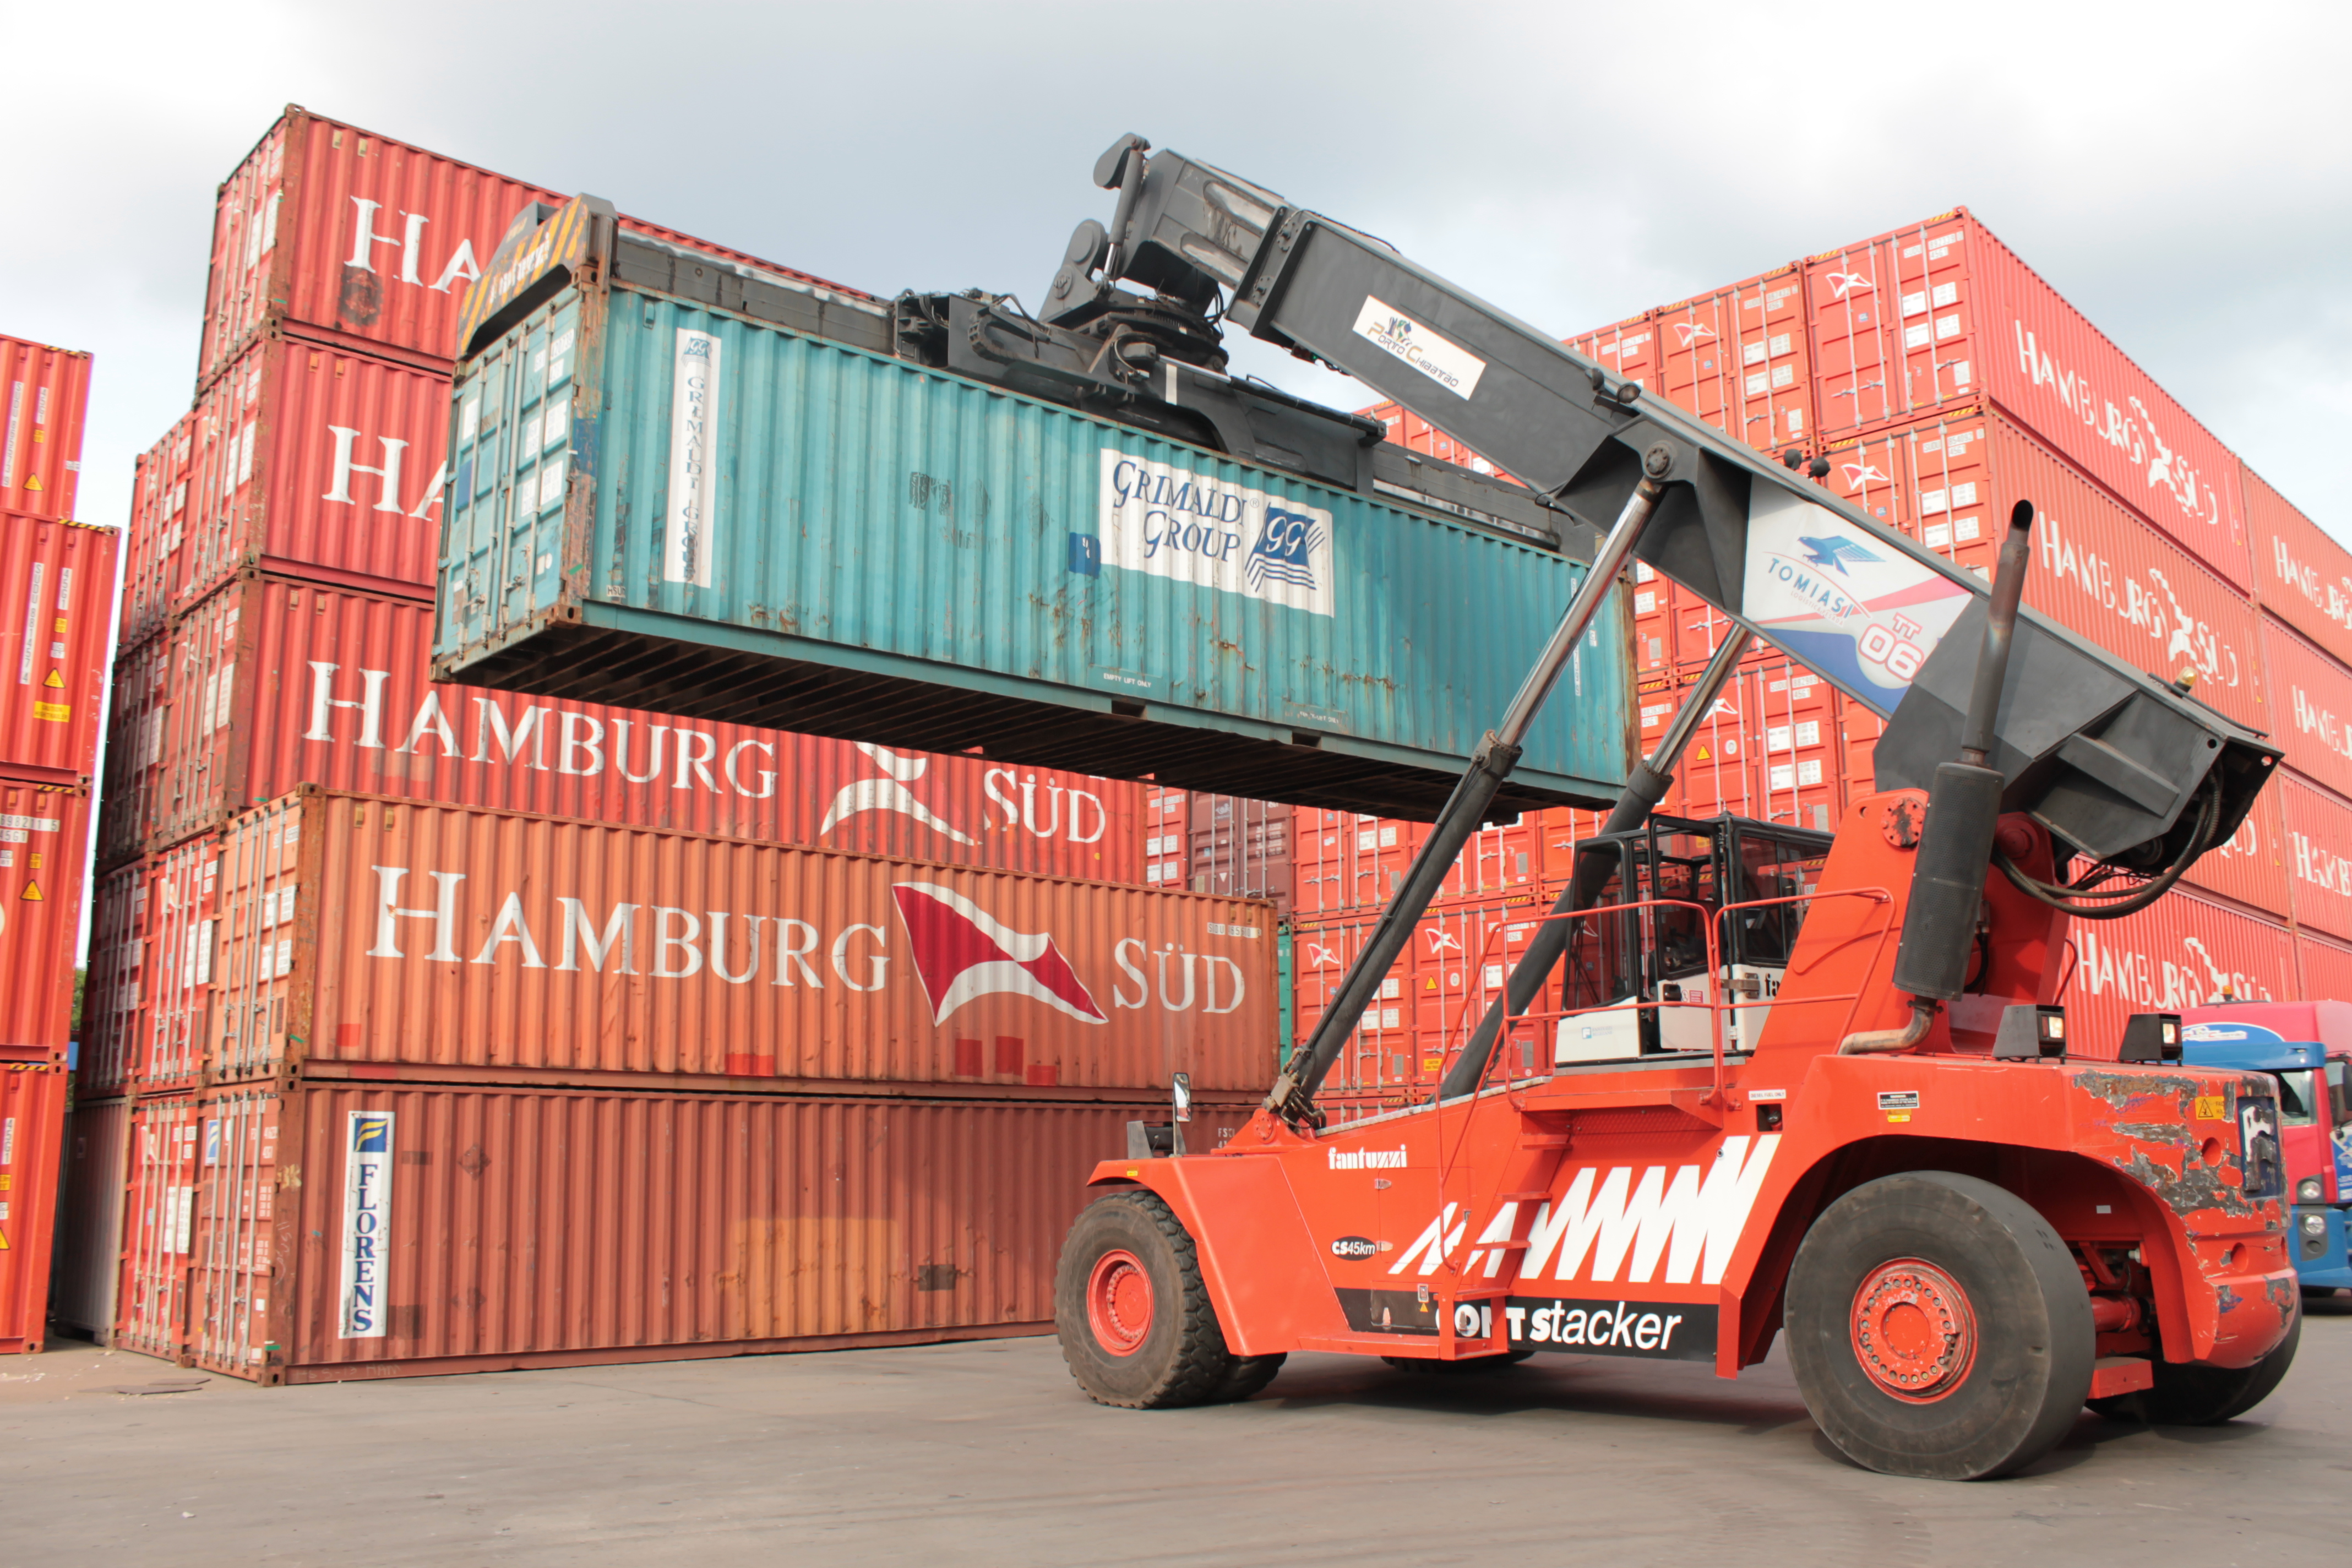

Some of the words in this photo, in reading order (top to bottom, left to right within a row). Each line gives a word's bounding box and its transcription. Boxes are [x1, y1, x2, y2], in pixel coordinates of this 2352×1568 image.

[1367, 322, 1405, 355] PORTO
[2015, 320, 2142, 464] HAMBURG
[1113, 460, 1247, 527] GRIMALDI
[1144, 510, 1241, 562] GROUP
[1768, 558, 1854, 618] TOMIASI
[2039, 511, 2162, 638] HAMBURG
[1858, 623, 1925, 682] 06
[1892, 612, 1923, 640] TT
[1103, 673, 1121, 682] EMPTY
[302, 661, 778, 799] HAMBURG
[984, 769, 1106, 844] SÜD
[366, 865, 891, 992] HAMBURG
[1113, 938, 1245, 1014] SÜD
[2076, 929, 2198, 1011] HAMBURG
[1328, 1144, 1408, 1169] fantuzzi
[352, 1163, 378, 1332] FLORENS
[1331, 1240, 1376, 1255] CS45km
